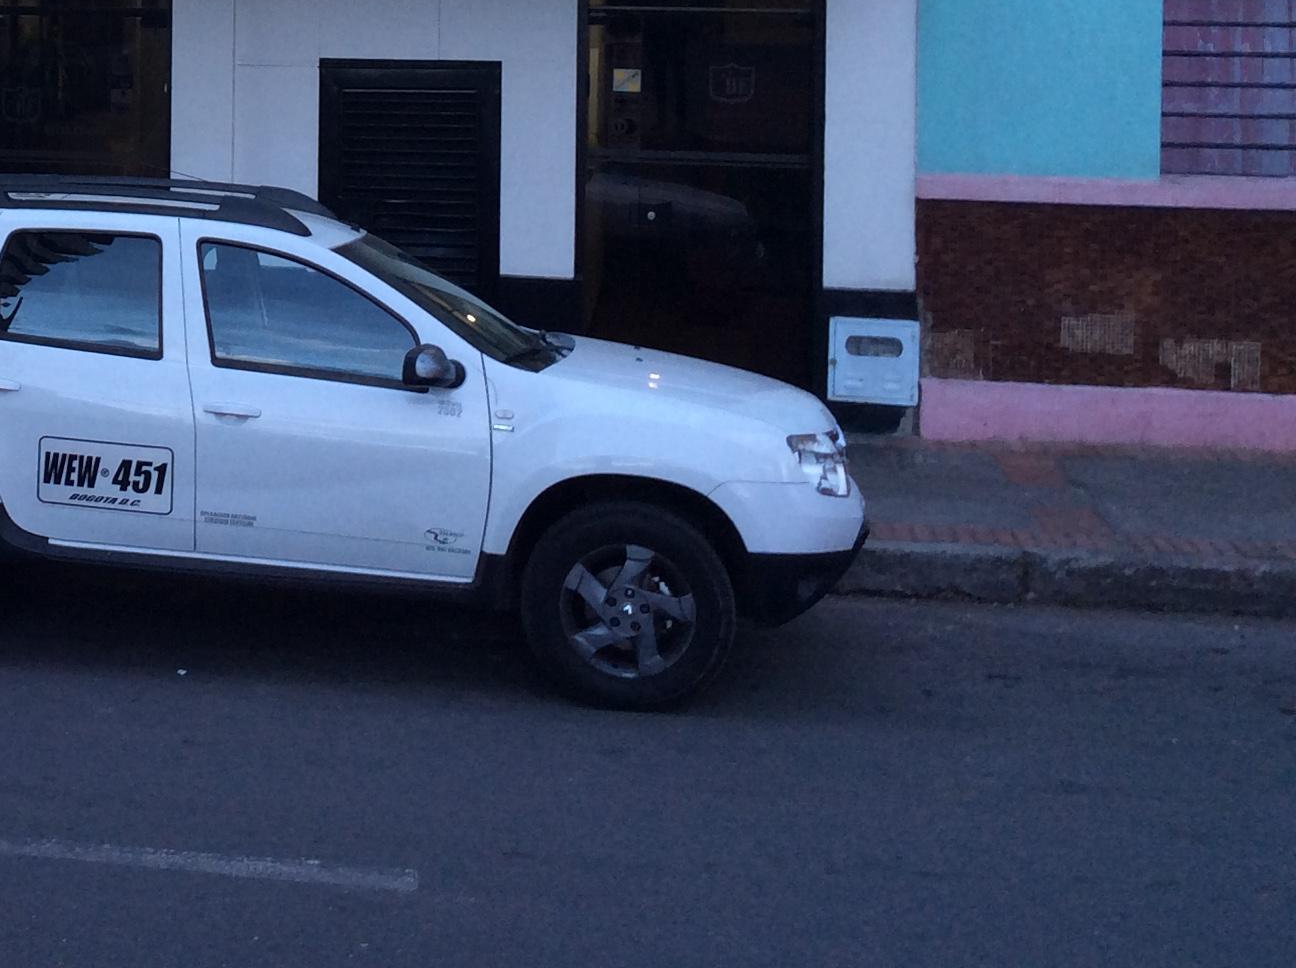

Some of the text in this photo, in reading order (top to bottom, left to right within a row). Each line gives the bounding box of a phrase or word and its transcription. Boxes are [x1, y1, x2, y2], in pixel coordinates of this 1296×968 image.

[43, 451, 168, 495] WEW 451
[68, 493, 117, 505] BOGOTA
